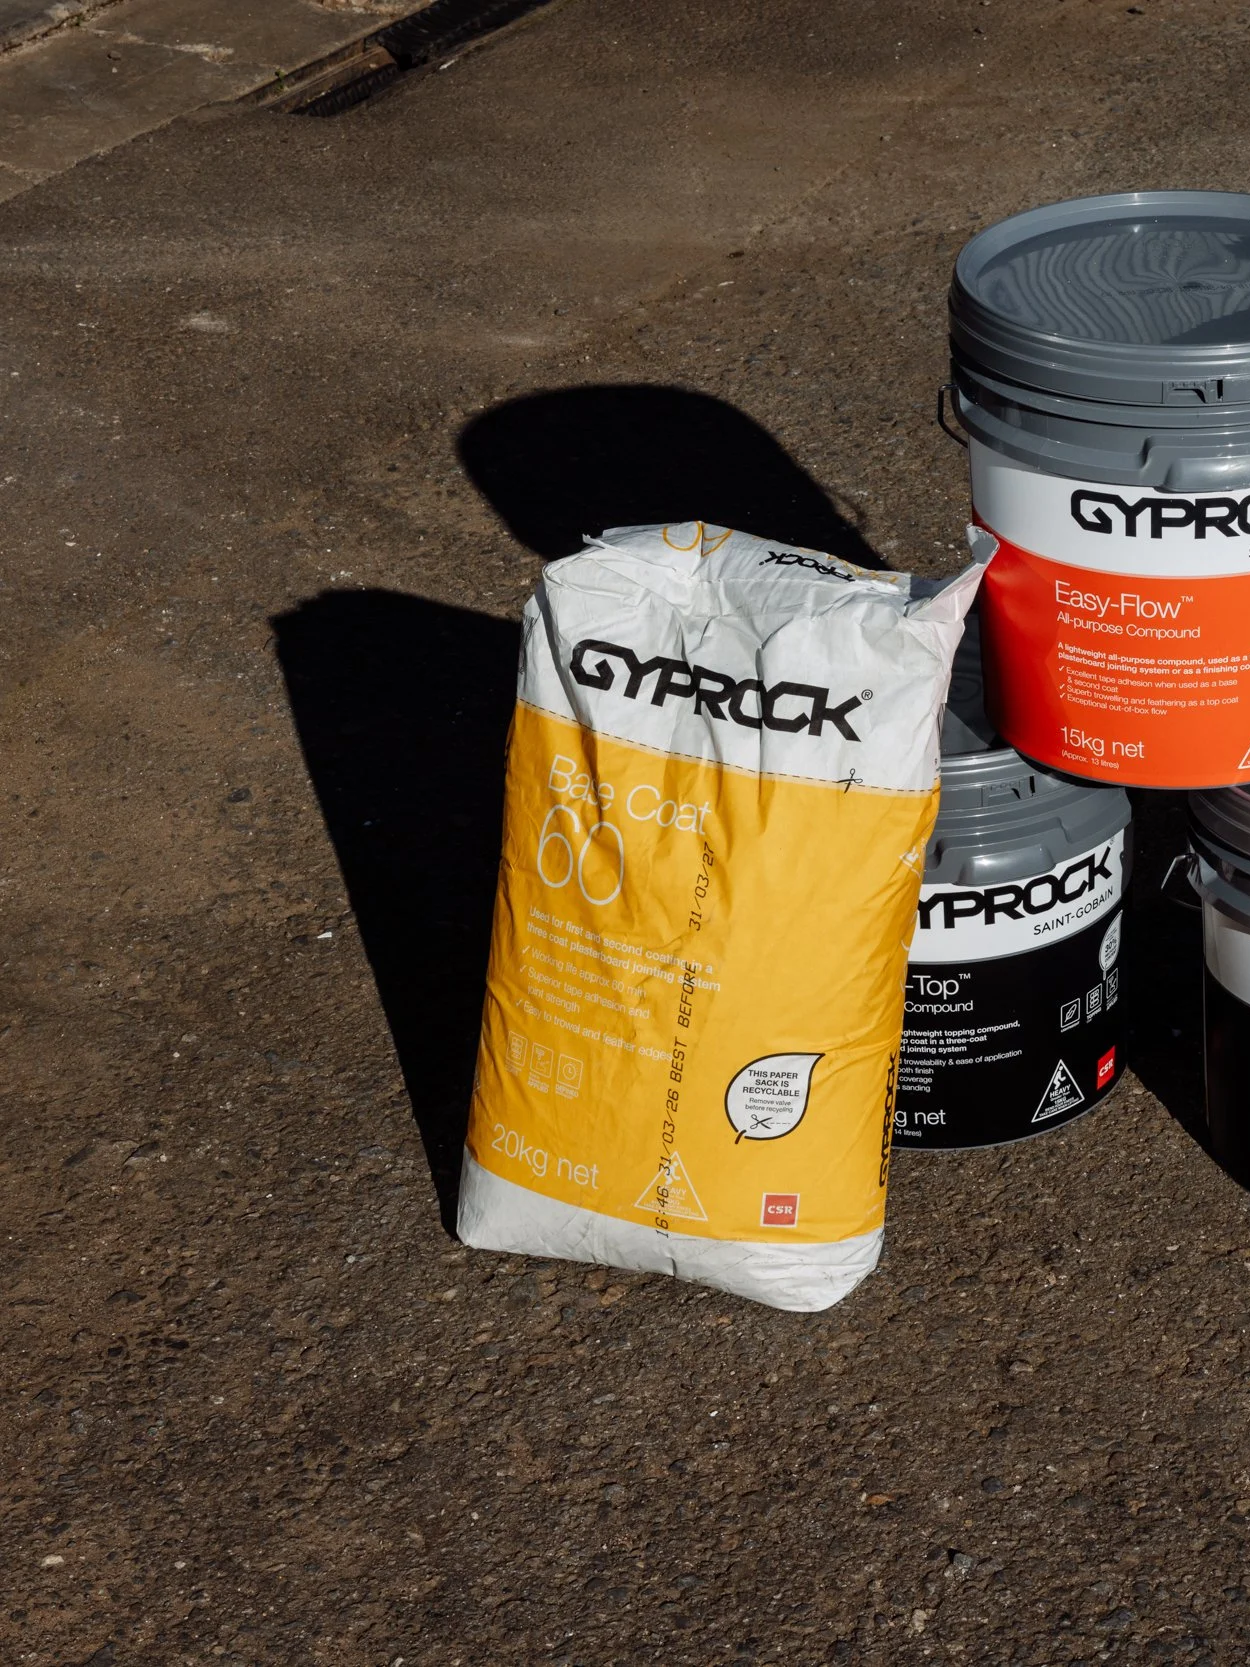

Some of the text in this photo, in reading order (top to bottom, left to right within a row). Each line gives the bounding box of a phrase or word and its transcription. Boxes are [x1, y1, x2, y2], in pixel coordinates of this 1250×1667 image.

[764, 551, 855, 582] PROCK
[1057, 611, 1200, 640] All-purpose Compound
[1058, 652, 1105, 668] plasterboard
[1107, 662, 1137, 674] jointing
[1139, 666, 1169, 675] system
[1203, 664, 1238, 674] finishing
[1065, 644, 1106, 659] lightweight
[1108, 653, 1155, 665] all-purpose
[1157, 657, 1205, 666] compound,
[1208, 656, 1228, 664] used
[1066, 667, 1097, 680] Excellent
[1099, 674, 1116, 684] tape
[1118, 678, 1152, 687] adhesion
[1155, 680, 1176, 688] when
[1074, 677, 1118, 693] second coat
[1066, 685, 1239, 708] Superb trowelling and feathering coat
[1067, 693, 1149, 715] Exceptional out-of-box
[1061, 726, 1144, 758] 15kg net
[1062, 749, 1088, 763] (Approx.
[627, 784, 711, 835] Coat
[537, 804, 624, 906] 60
[917, 846, 1112, 929] YPROCK
[1033, 886, 1113, 935] SAINT-GOBAIN
[530, 905, 686, 970] Used first second coating
[527, 921, 674, 983] three coat plasterboard jointing
[531, 947, 609, 988] Working approx
[528, 966, 650, 1019] Superior adhesion and
[545, 992, 580, 1013] strength
[904, 1000, 973, 1015] Compound
[523, 1001, 673, 1062] Easy trowel feather edges
[655, 841, 714, 1238] 16:46 31/03/26 BEST BEFORE 31/03/27
[944, 1029, 975, 1037] topping
[946, 1034, 987, 1045] three-coat
[904, 1058, 946, 1067] trowelability
[984, 1049, 1022, 1062] application
[907, 1045, 967, 1054] jointing system
[748, 1069, 798, 1080] THIS PAPER
[1099, 1058, 1113, 1077] CSR
[755, 1079, 779, 1087] SACK
[899, 1075, 932, 1083] coverage
[902, 1085, 931, 1093] sanding
[742, 1086, 800, 1097] RECYCLABLE
[749, 1097, 774, 1106] Remove
[1050, 1084, 1071, 1098] HEAVY
[745, 1104, 793, 1114] before recycling
[914, 1109, 946, 1125] net
[491, 1123, 599, 1190] 20kg net
[767, 1205, 793, 1214] CSR
